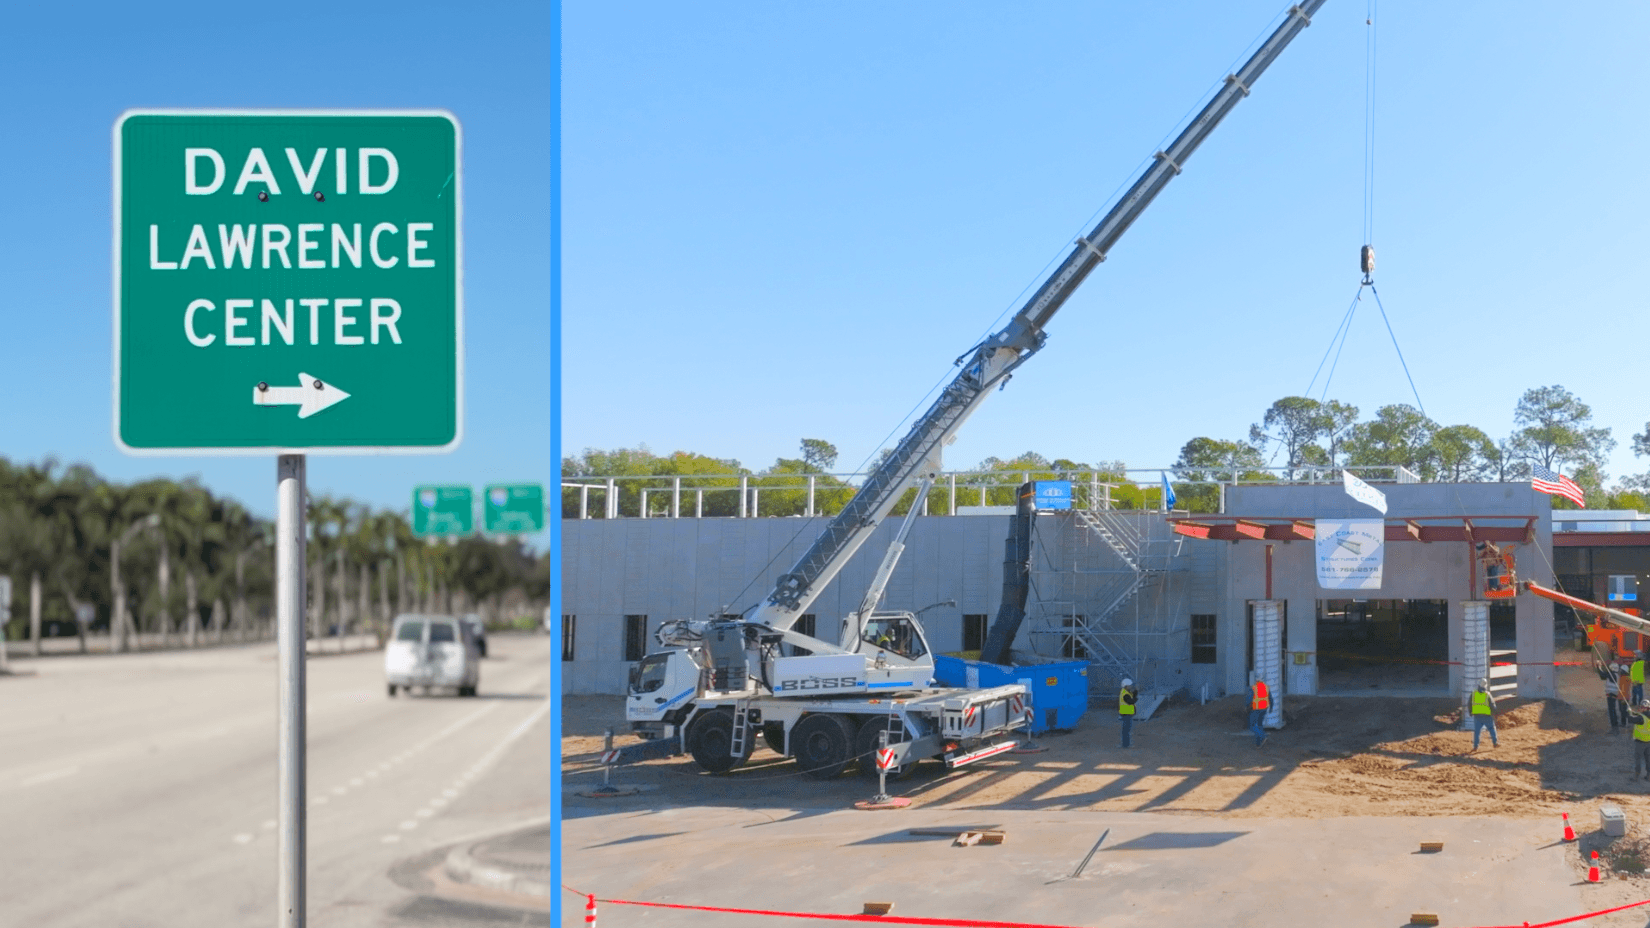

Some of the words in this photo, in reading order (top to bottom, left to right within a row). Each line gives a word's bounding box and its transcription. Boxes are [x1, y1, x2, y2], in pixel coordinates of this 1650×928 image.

[184, 147, 399, 195] DAVID
[149, 222, 436, 270] LAWRENCE
[184, 298, 403, 347] CENTER
[782, 677, 856, 690] BOSS
